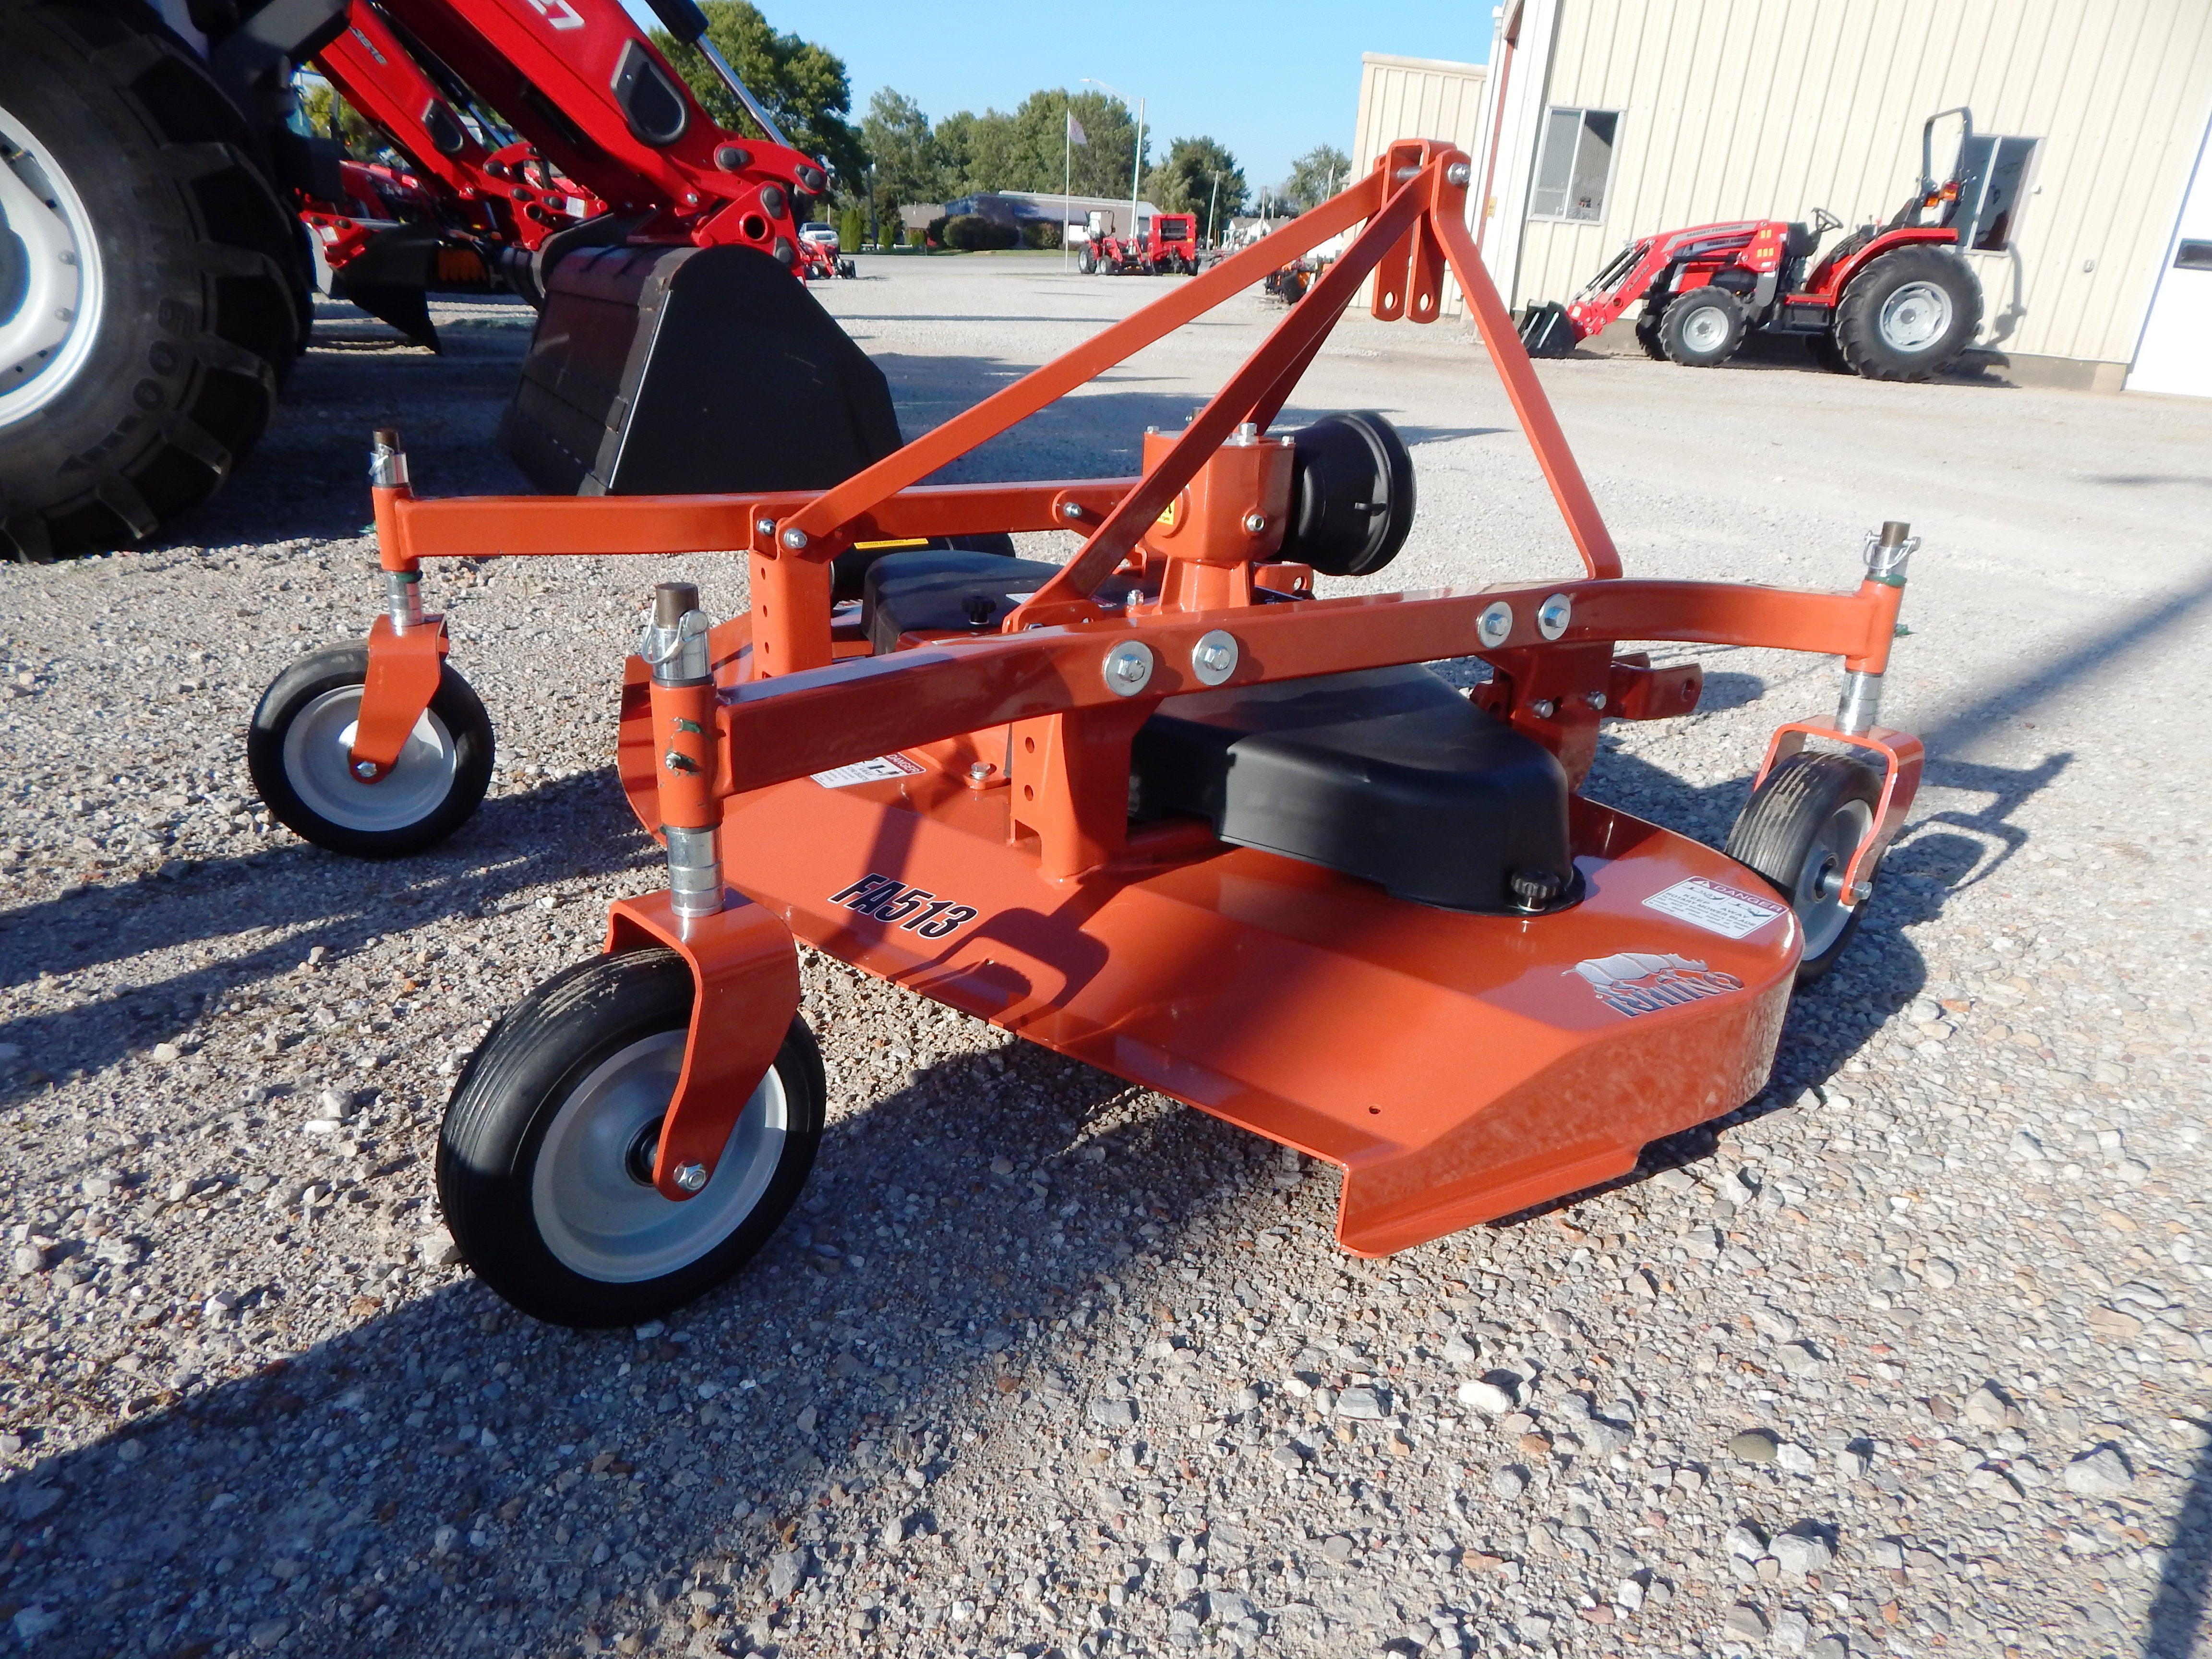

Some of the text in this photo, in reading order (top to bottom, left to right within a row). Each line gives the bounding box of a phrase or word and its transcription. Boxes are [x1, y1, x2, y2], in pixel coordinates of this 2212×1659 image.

[1687, 229, 1710, 237] MASSEY
[886, 754, 920, 773] DANGER
[827, 873, 978, 939] FA513
[1665, 892, 1756, 926] ROTARY MOWER BLADE
[1683, 894, 1749, 918] KEEP AWAY
[1713, 885, 1783, 912] DANGER
[1602, 971, 1744, 1018] RHINO
